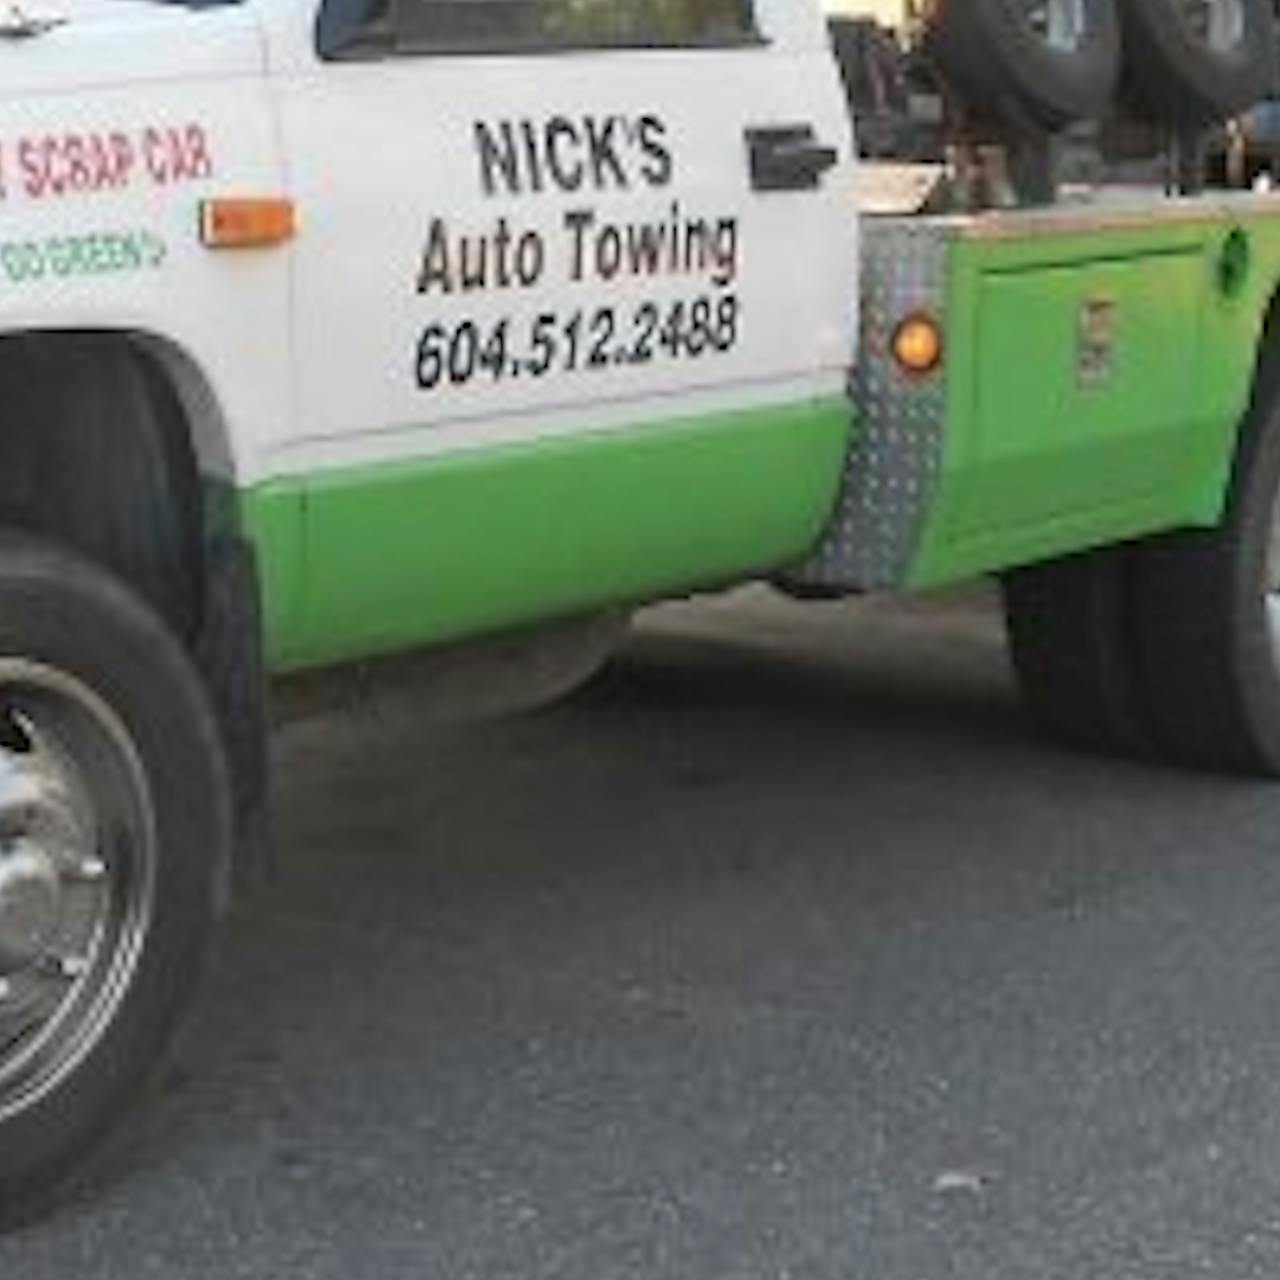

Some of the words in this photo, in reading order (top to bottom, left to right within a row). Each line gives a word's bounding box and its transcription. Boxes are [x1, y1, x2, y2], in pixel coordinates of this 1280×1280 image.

[19, 134, 134, 199] SCRAP
[145, 125, 214, 187] CAR
[474, 116, 673, 195] NICK'S
[46, 230, 142, 277] GREEN
[416, 217, 544, 294] Auto
[564, 199, 738, 288] Towing
[414, 295, 738, 390] 604.512.2488
